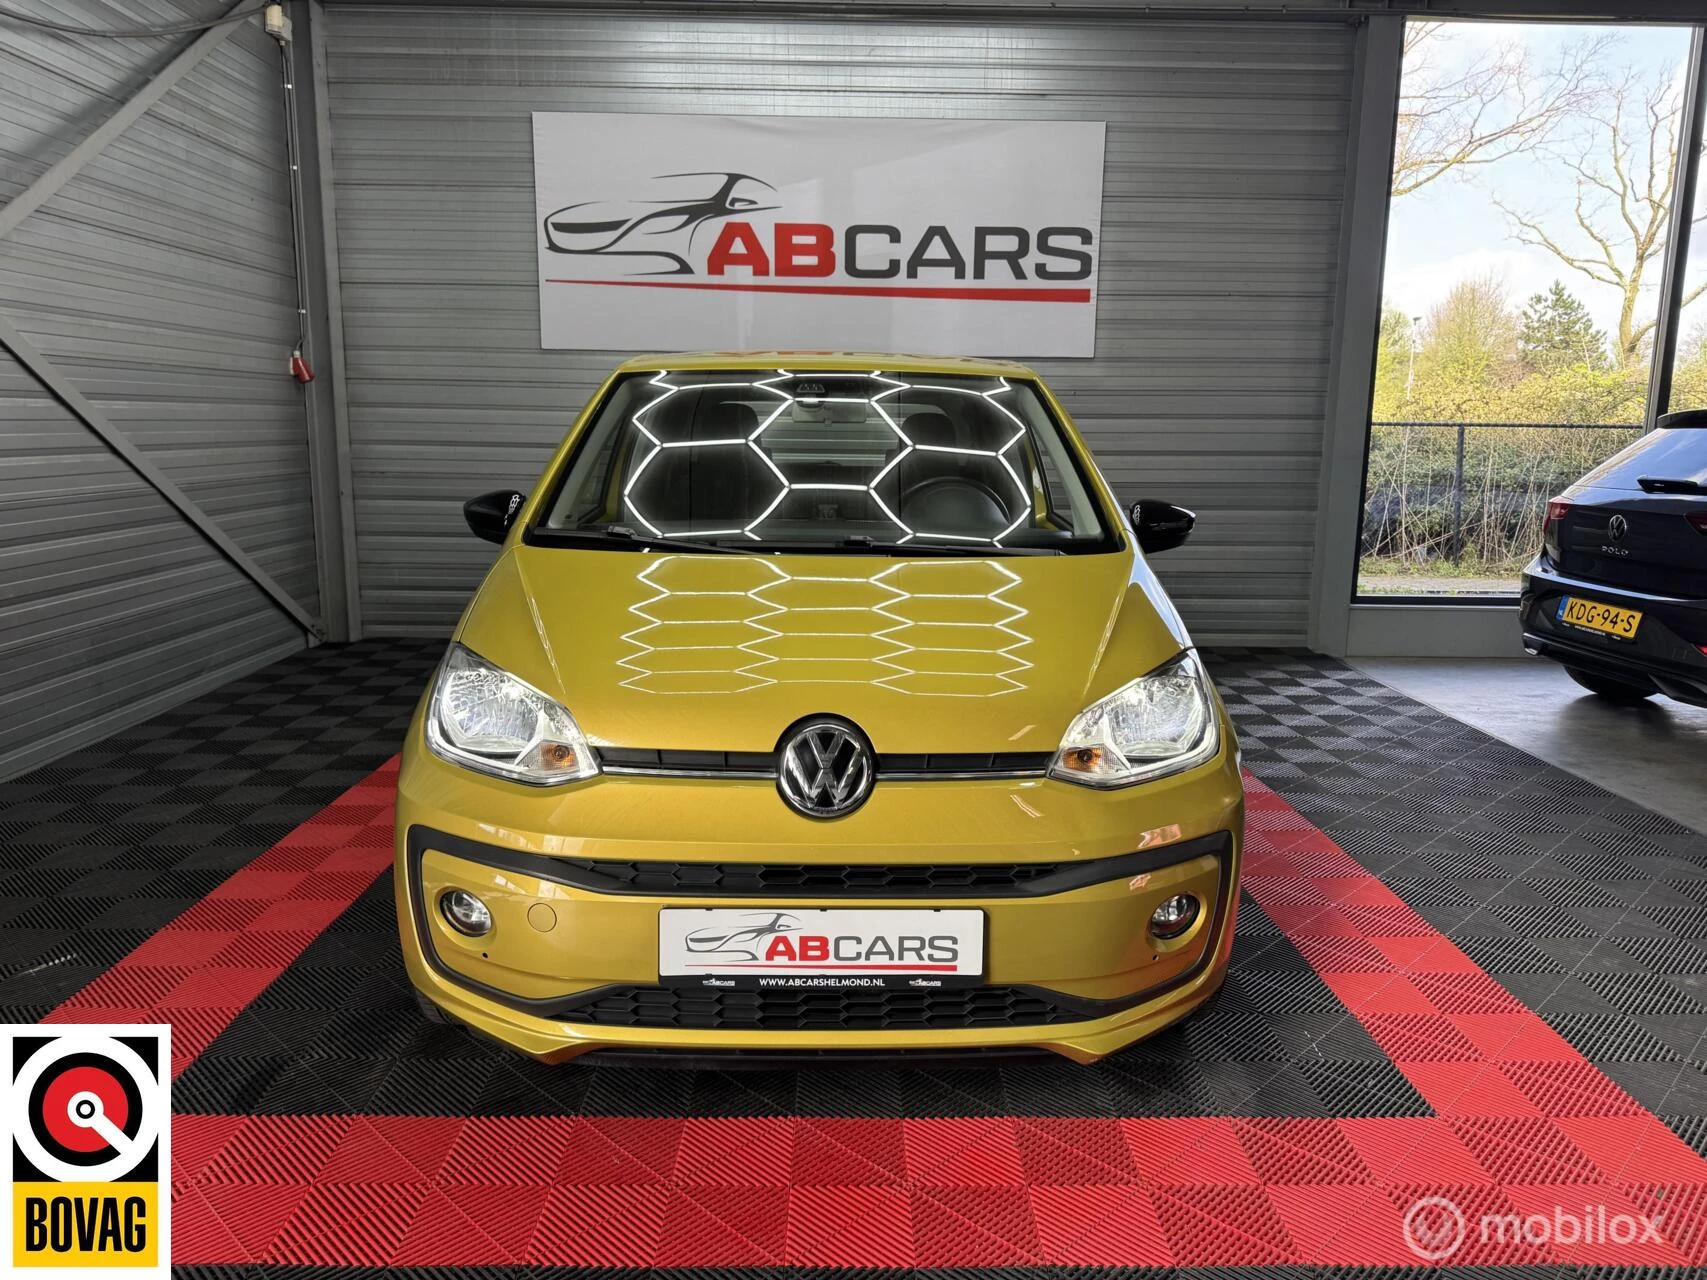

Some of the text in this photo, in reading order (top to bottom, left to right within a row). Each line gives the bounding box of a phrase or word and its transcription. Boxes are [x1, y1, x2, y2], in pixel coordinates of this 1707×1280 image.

[707, 222, 1092, 281] ABCARS
[1601, 545, 1629, 556] POLO
[1566, 601, 1636, 633] KDG-94-S
[765, 935, 958, 963] ABCARS
[759, 977, 886, 988] WWW.ABCARSHELMOND.NL
